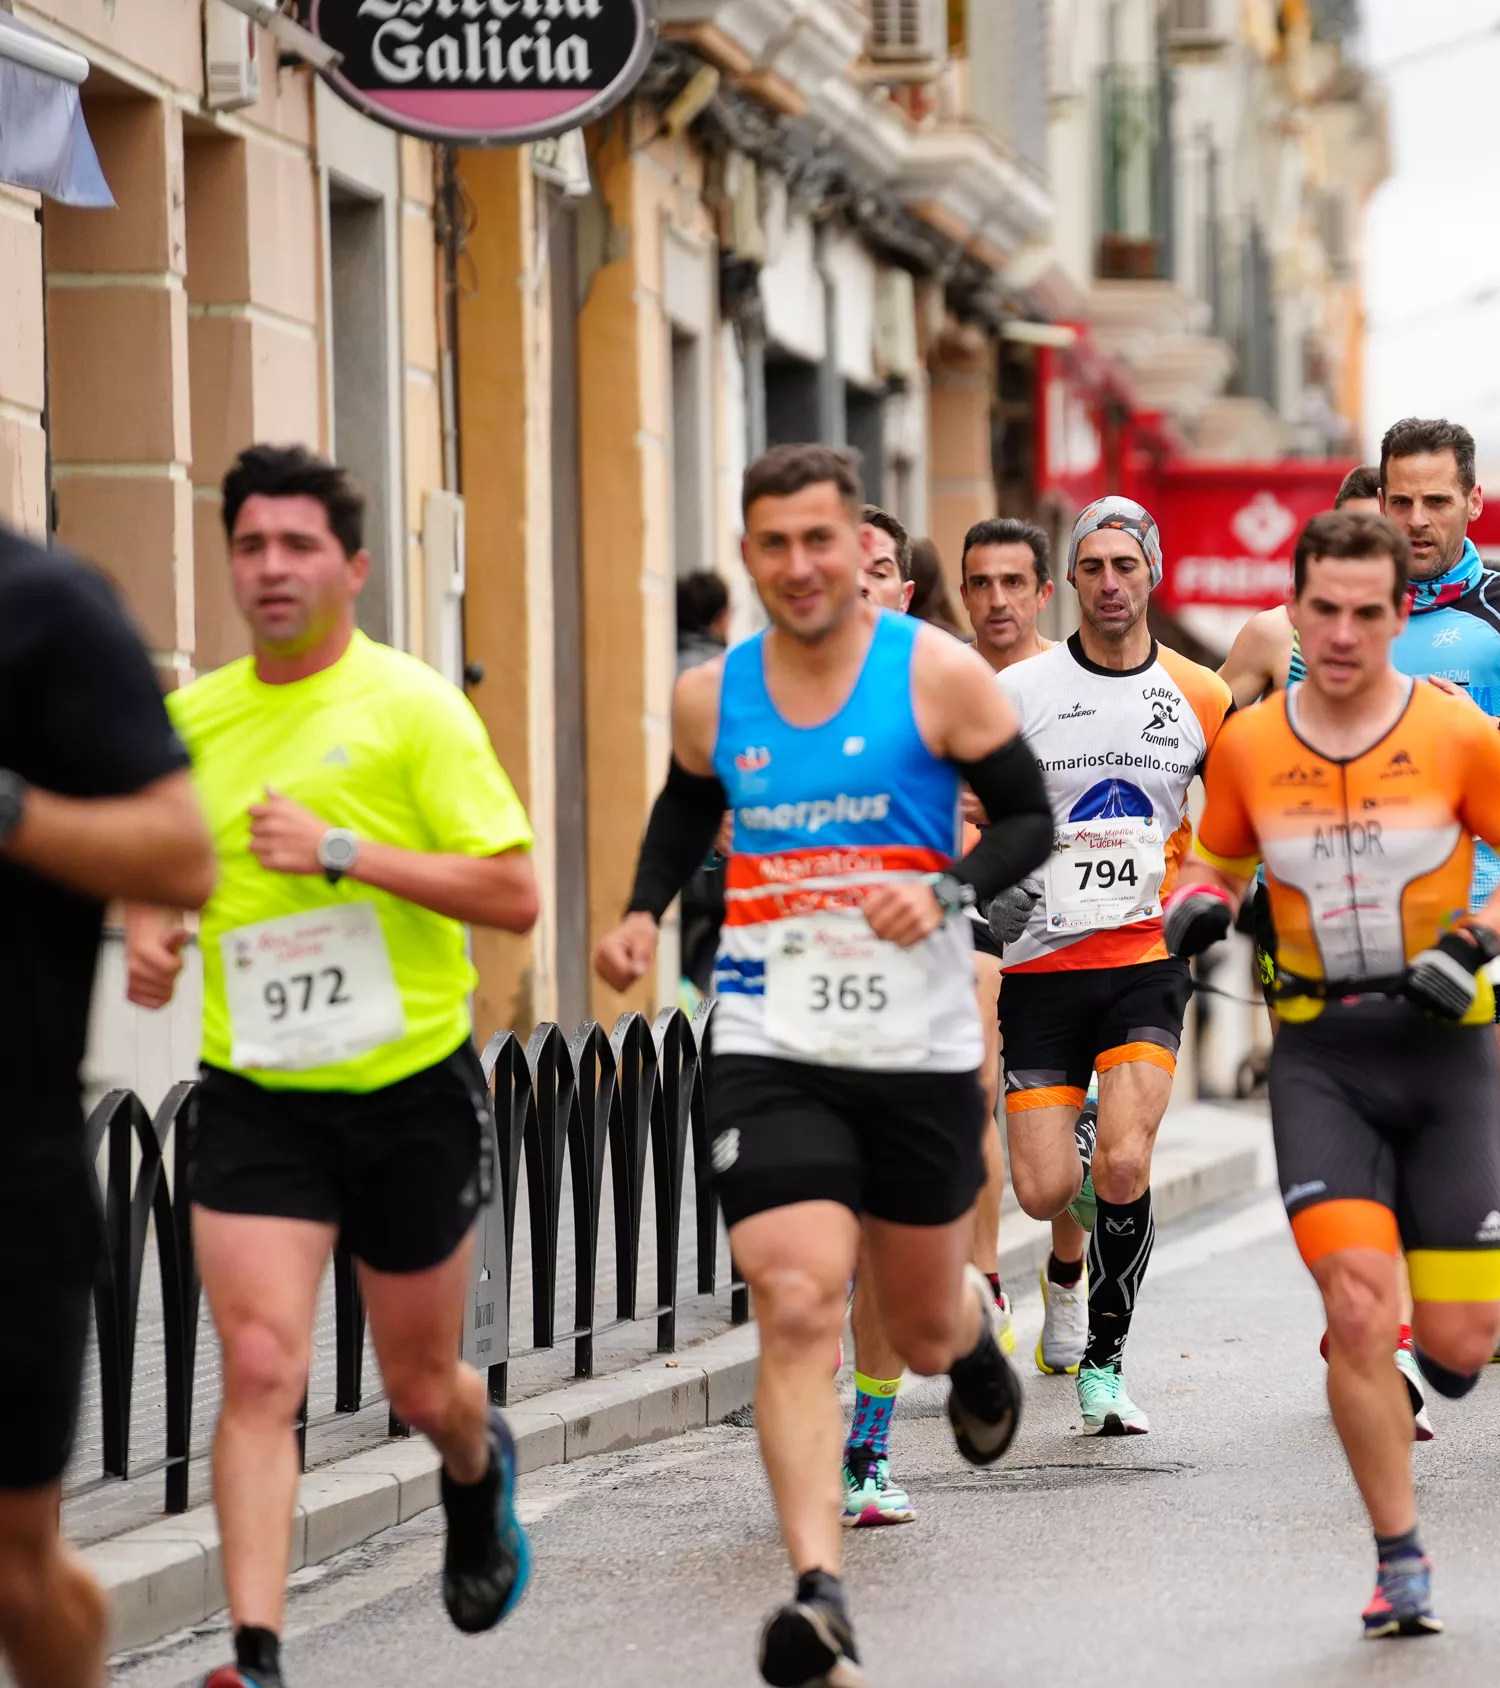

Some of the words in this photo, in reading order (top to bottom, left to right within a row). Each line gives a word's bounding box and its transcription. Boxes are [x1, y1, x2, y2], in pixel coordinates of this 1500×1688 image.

[371, 18, 593, 83] Galicia
[1142, 687, 1181, 706] CABRA
[1057, 709, 1097, 720] TEAMERGY
[1141, 731, 1179, 749] running
[1036, 752, 1189, 775] ArmariosCabello.com
[1090, 839, 1127, 849] LUCENA
[1313, 820, 1385, 860] AITOR
[1074, 858, 1138, 890] 794
[264, 966, 352, 1021] 972
[810, 973, 889, 1013] 365
